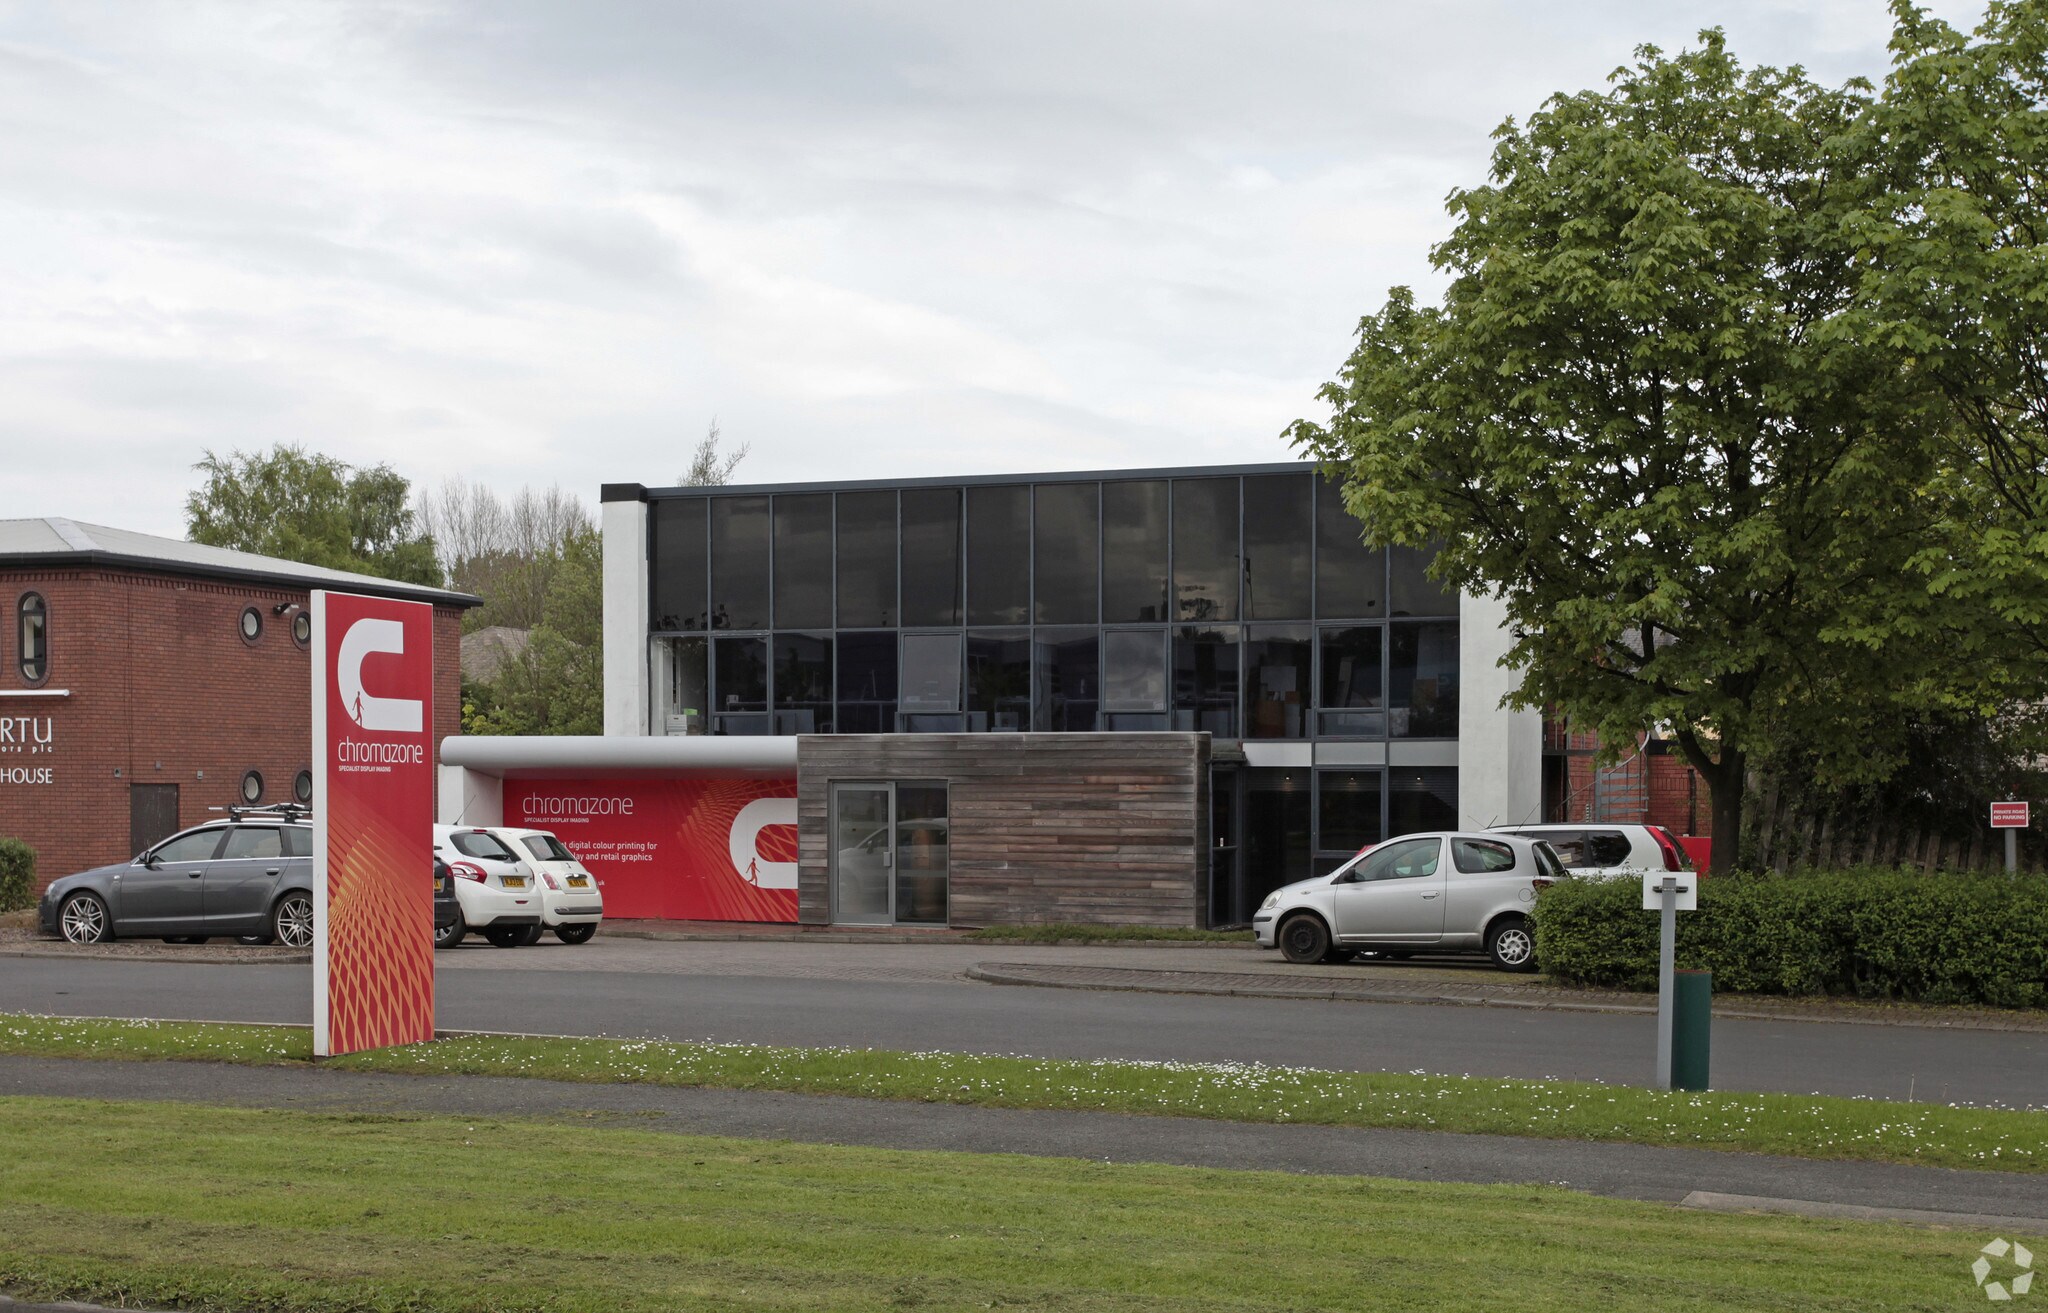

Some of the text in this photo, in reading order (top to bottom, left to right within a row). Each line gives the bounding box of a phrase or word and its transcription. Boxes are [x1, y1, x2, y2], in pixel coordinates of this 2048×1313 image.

[0, 717, 52, 743] RTU
[32, 743, 53, 755] plc
[338, 735, 423, 764] chromazone
[0, 767, 53, 784] HOUSE
[522, 791, 634, 815] chromazone
[568, 841, 591, 851] digital
[592, 841, 616, 850] colour
[616, 841, 645, 851] printing
[647, 842, 658, 850] for
[585, 852, 599, 861] and
[600, 853, 620, 861] retail
[621, 853, 653, 863] graphics
